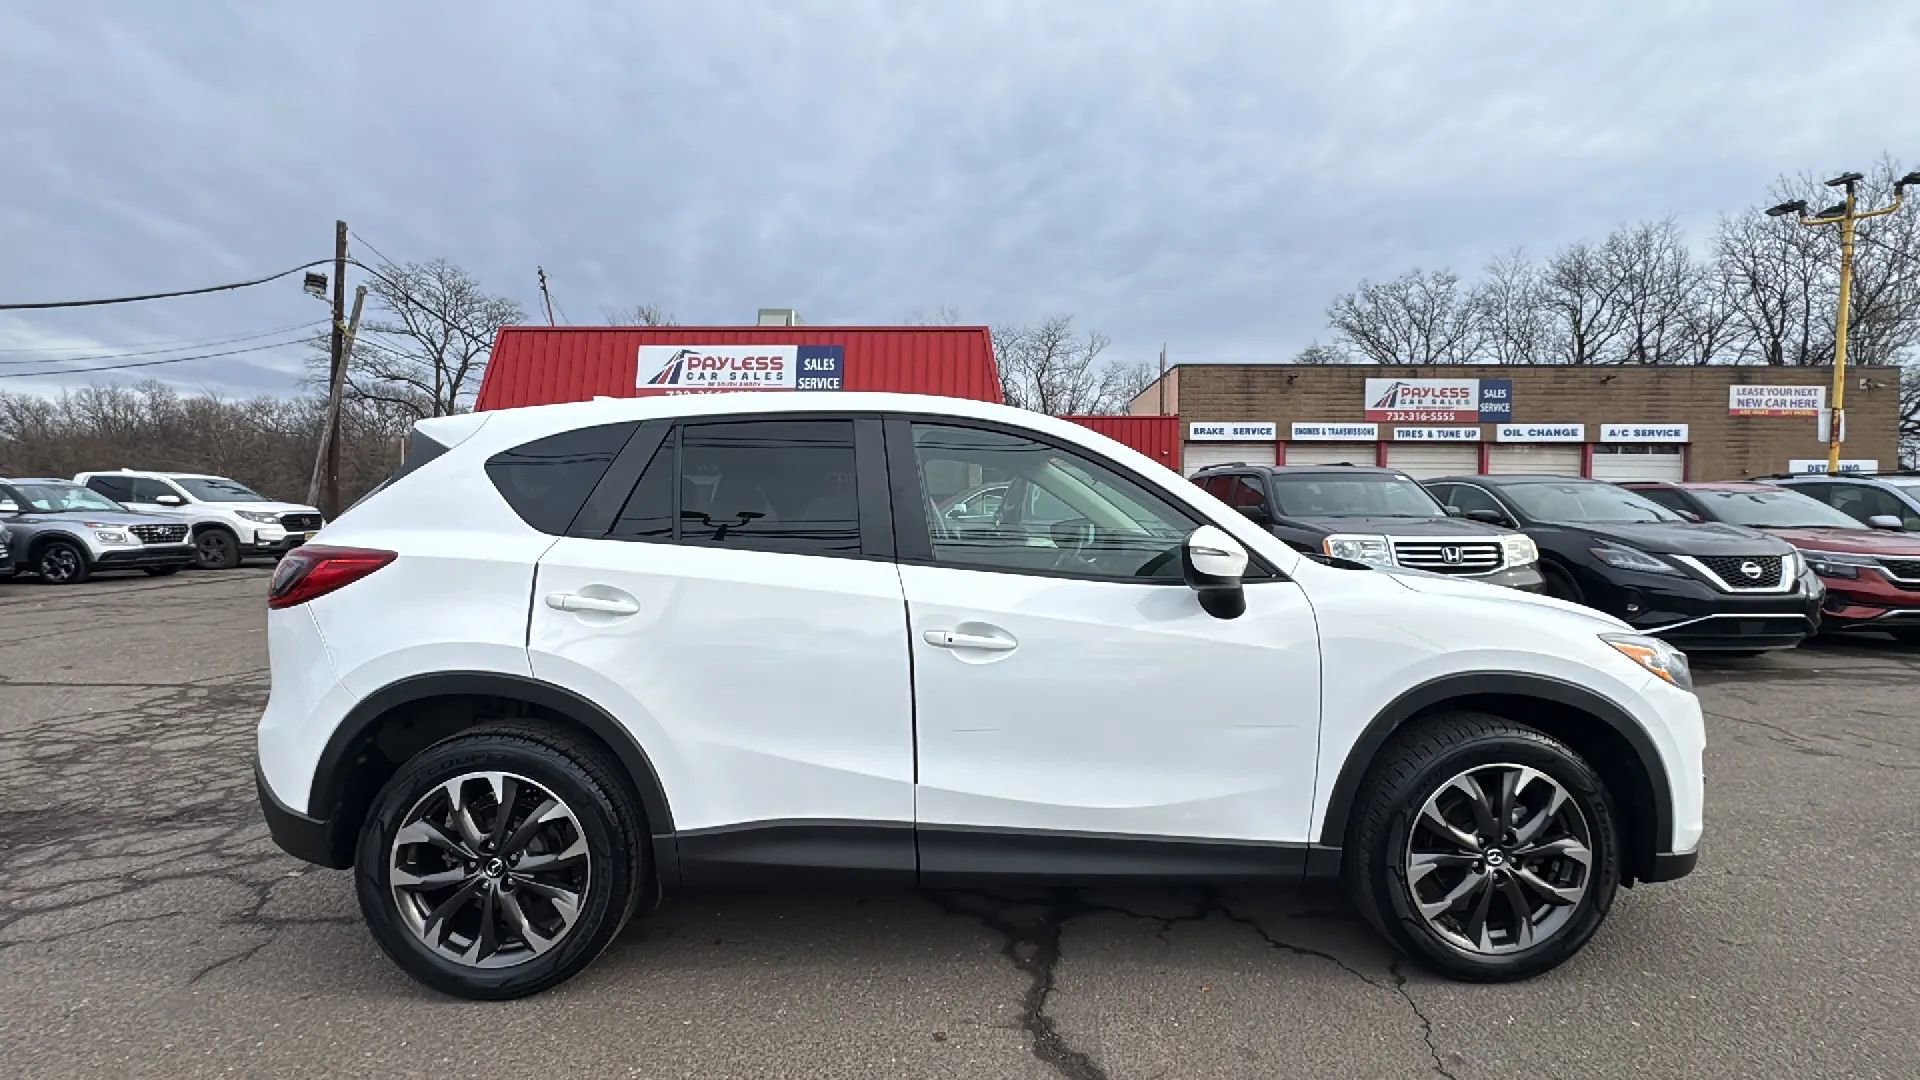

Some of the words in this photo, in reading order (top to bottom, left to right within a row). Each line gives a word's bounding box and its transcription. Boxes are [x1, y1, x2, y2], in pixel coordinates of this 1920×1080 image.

[687, 356, 784, 371] PAYLESS
[803, 358, 835, 371] SALES
[686, 372, 718, 381] CAR
[729, 372, 783, 381] SALES
[798, 377, 840, 389] SERVICE
[1401, 387, 1470, 398] PAYLESS
[1483, 389, 1507, 399] SALES
[1736, 388, 1765, 396] LEASE
[1766, 388, 1792, 397] YOUR
[1794, 388, 1819, 397] NEXT
[1479, 402, 1511, 413] SERVICE
[1737, 398, 1763, 407] NEW
[1765, 399, 1787, 408] CAR
[1789, 399, 1817, 408] HERE
[1386, 411, 1455, 421] 732-316-5555
[1193, 427, 1225, 435] BRAKE
[1232, 427, 1272, 435] SERVICE
[1294, 427, 1320, 435] ENGINES
[1328, 427, 1375, 436] TRANSMISSIONS
[1397, 430, 1424, 438] TIRES
[1437, 430, 1461, 438] TUNE
[1464, 430, 1477, 438] UP
[1503, 428, 1523, 436] OIL
[1527, 428, 1579, 436] CHANGE
[1608, 429, 1629, 437] A/C
[1633, 429, 1681, 437] SERVICE
[1807, 464, 1860, 472] DETING
